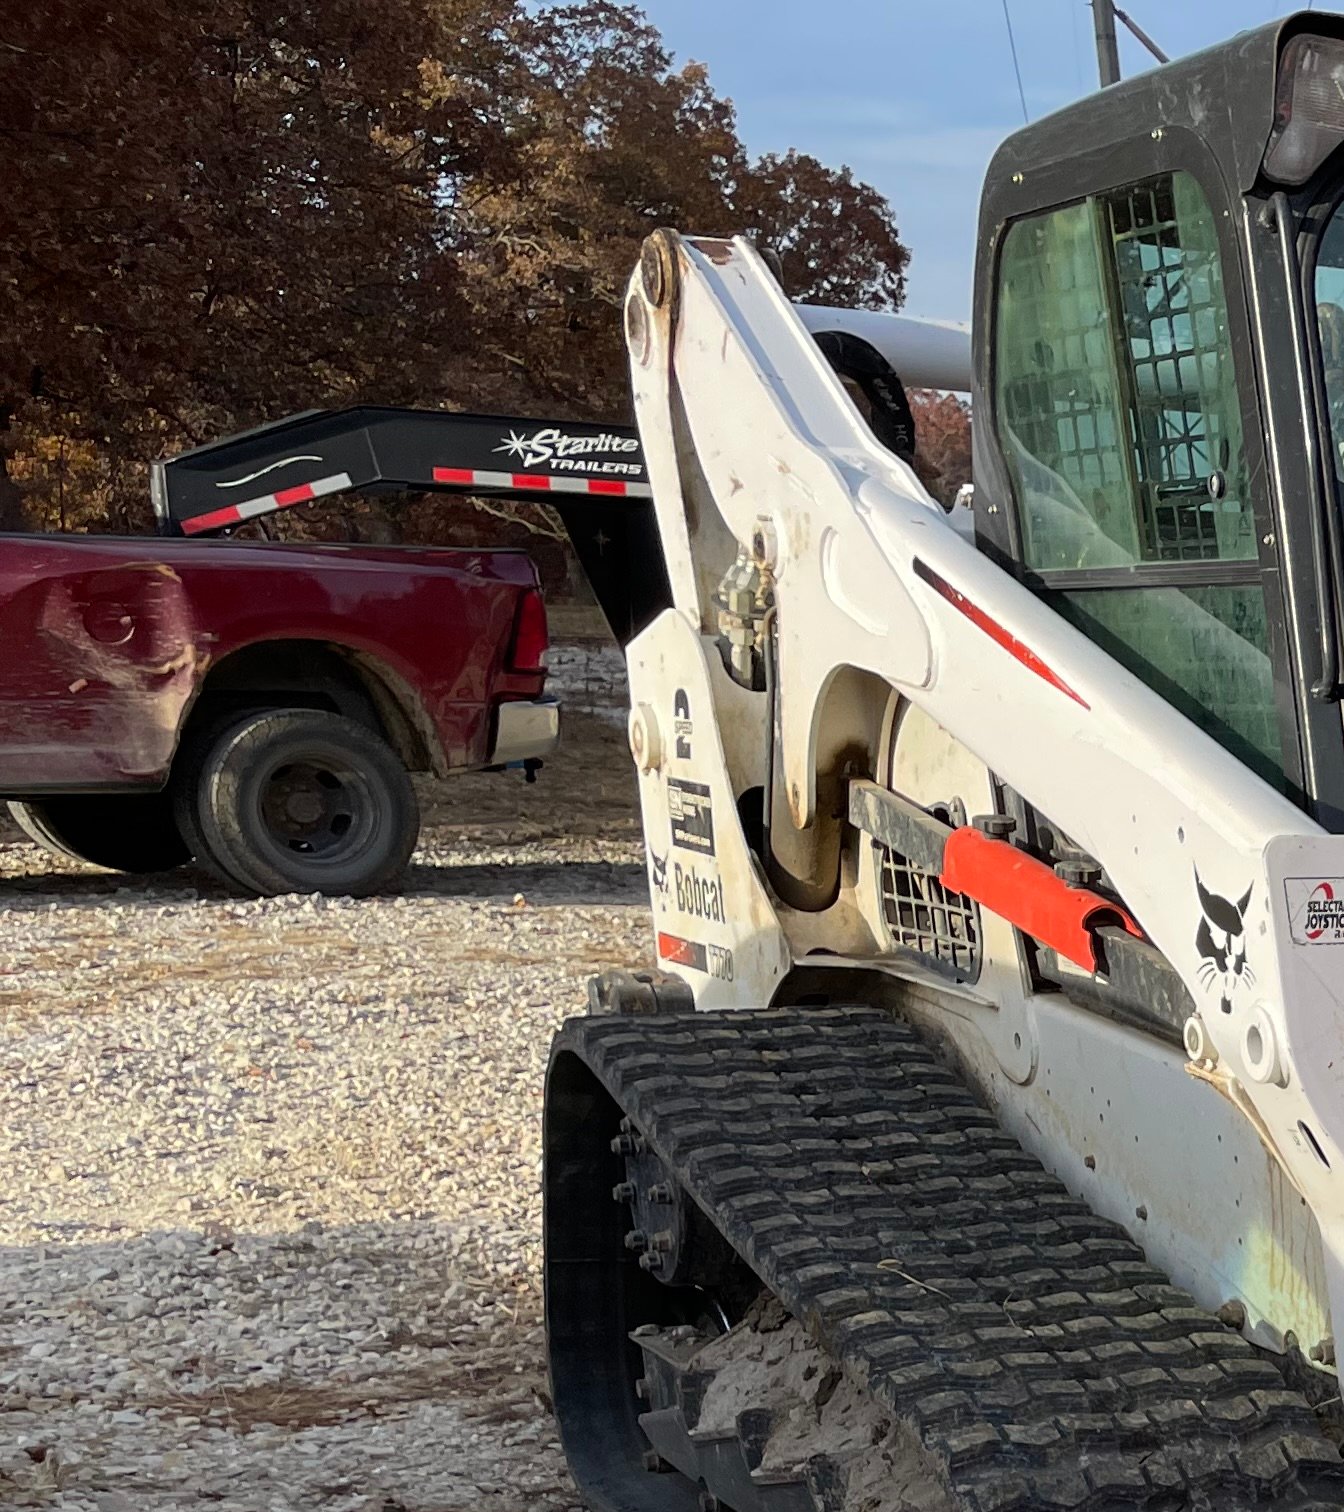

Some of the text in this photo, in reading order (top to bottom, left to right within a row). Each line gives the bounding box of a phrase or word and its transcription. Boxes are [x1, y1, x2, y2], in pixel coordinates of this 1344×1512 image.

[523, 428, 639, 468] Starlite
[550, 458, 642, 475] TRAILERS
[675, 862, 726, 924] Bobcat
